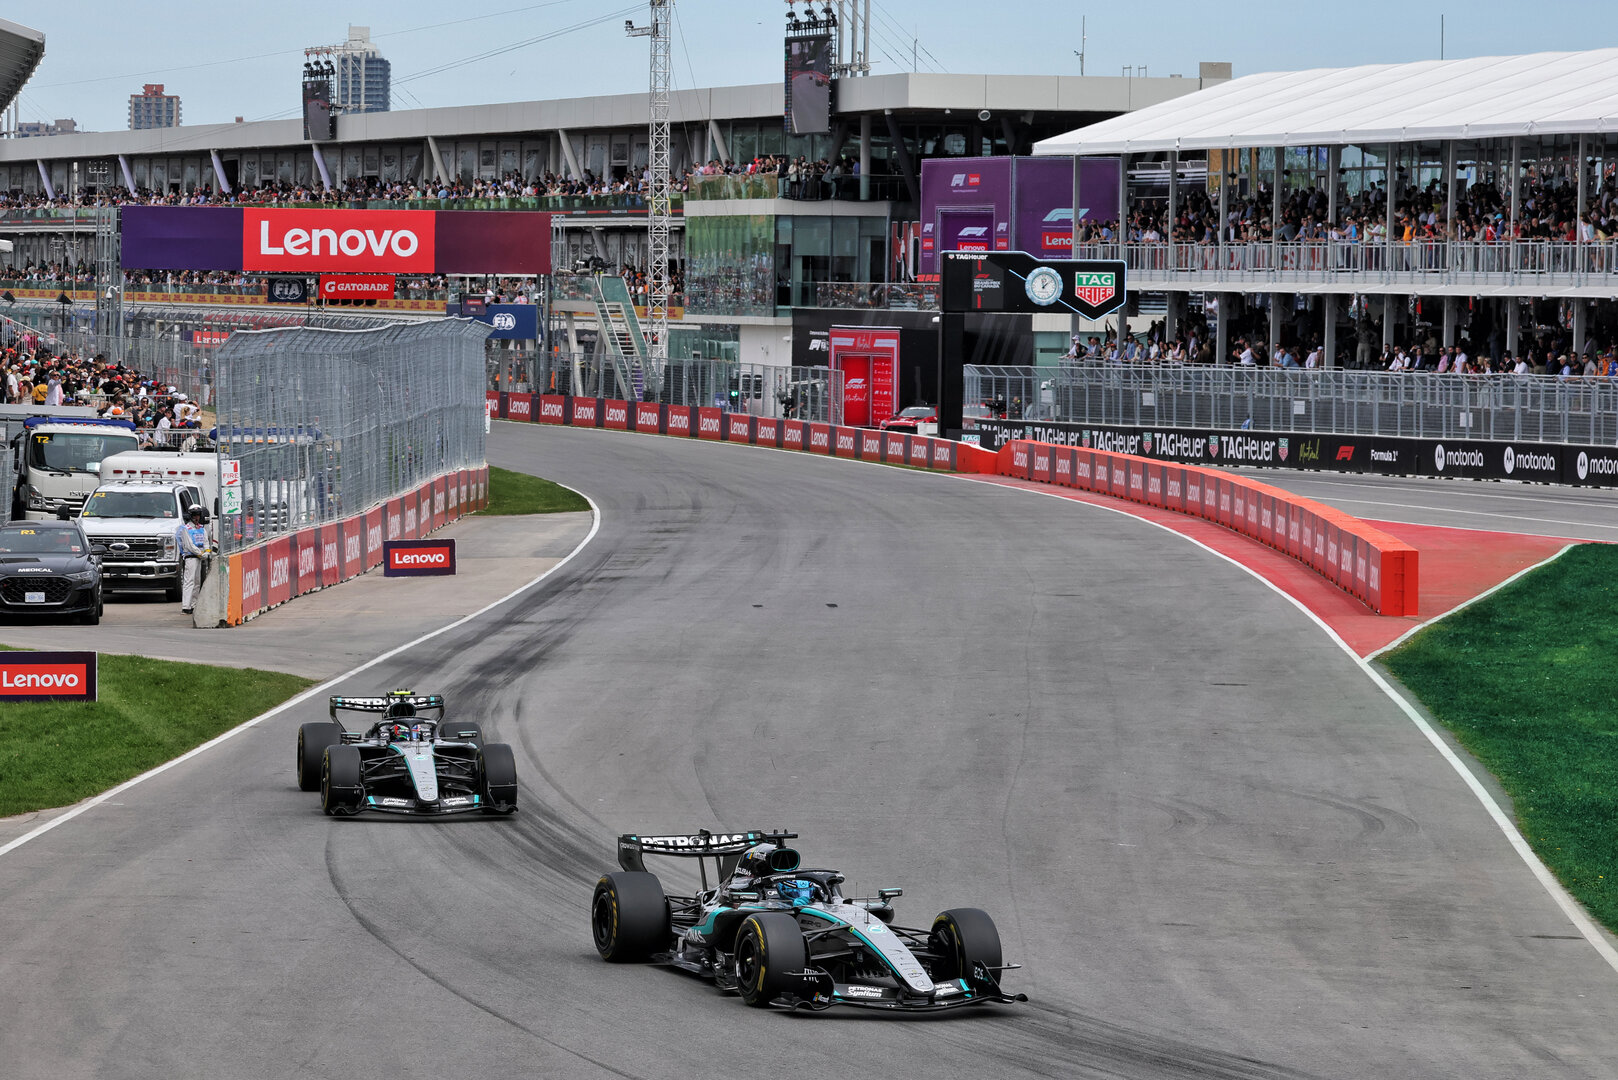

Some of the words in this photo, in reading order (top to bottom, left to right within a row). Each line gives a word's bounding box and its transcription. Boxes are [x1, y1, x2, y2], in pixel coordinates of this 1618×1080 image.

[260, 220, 418, 257] Lenovo
[1046, 236, 1072, 245] Leno
[325, 281, 335, 292] G
[337, 283, 389, 291] GATORADE
[1079, 275, 1111, 285] TAG
[1078, 288, 1113, 303] HEUER
[494, 316, 513, 327] FIA
[509, 398, 529, 414] Lenovo
[541, 400, 562, 417] Lenovo
[574, 403, 594, 420] Lenovo
[606, 405, 626, 422] Lenovo
[637, 408, 658, 426] Lenovo
[669, 411, 688, 429] Lenovo
[700, 414, 719, 432] Lenovo
[730, 418, 748, 436] Lenovo
[758, 422, 775, 440] Lenovo
[784, 425, 801, 442] Lenovo
[36, 435, 49, 443] T2
[811, 429, 828, 447] Lenovo
[837, 432, 853, 450] Lenovo
[1092, 431, 1140, 454] TAGHeuer
[1154, 433, 1206, 457] TAGHeuer
[1221, 436, 1275, 461] TAGHeuer
[1371, 449, 1392, 461] Formula
[1014, 448, 1027, 468] Lenovo
[1035, 452, 1048, 471] Lenovo
[1447, 449, 1483, 467] motorola
[1516, 452, 1555, 471] motorola
[1590, 456, 1618, 474] motor
[322, 538, 337, 570] Lenovo
[345, 531, 360, 563] Lenovo
[298, 544, 314, 577] Lenovo
[395, 553, 445, 564] Lenovo
[270, 554, 288, 588] Lenovo
[243, 567, 260, 600] Lenovo
[2, 671, 79, 687] Lenovo
[847, 989, 882, 997] Syntium
